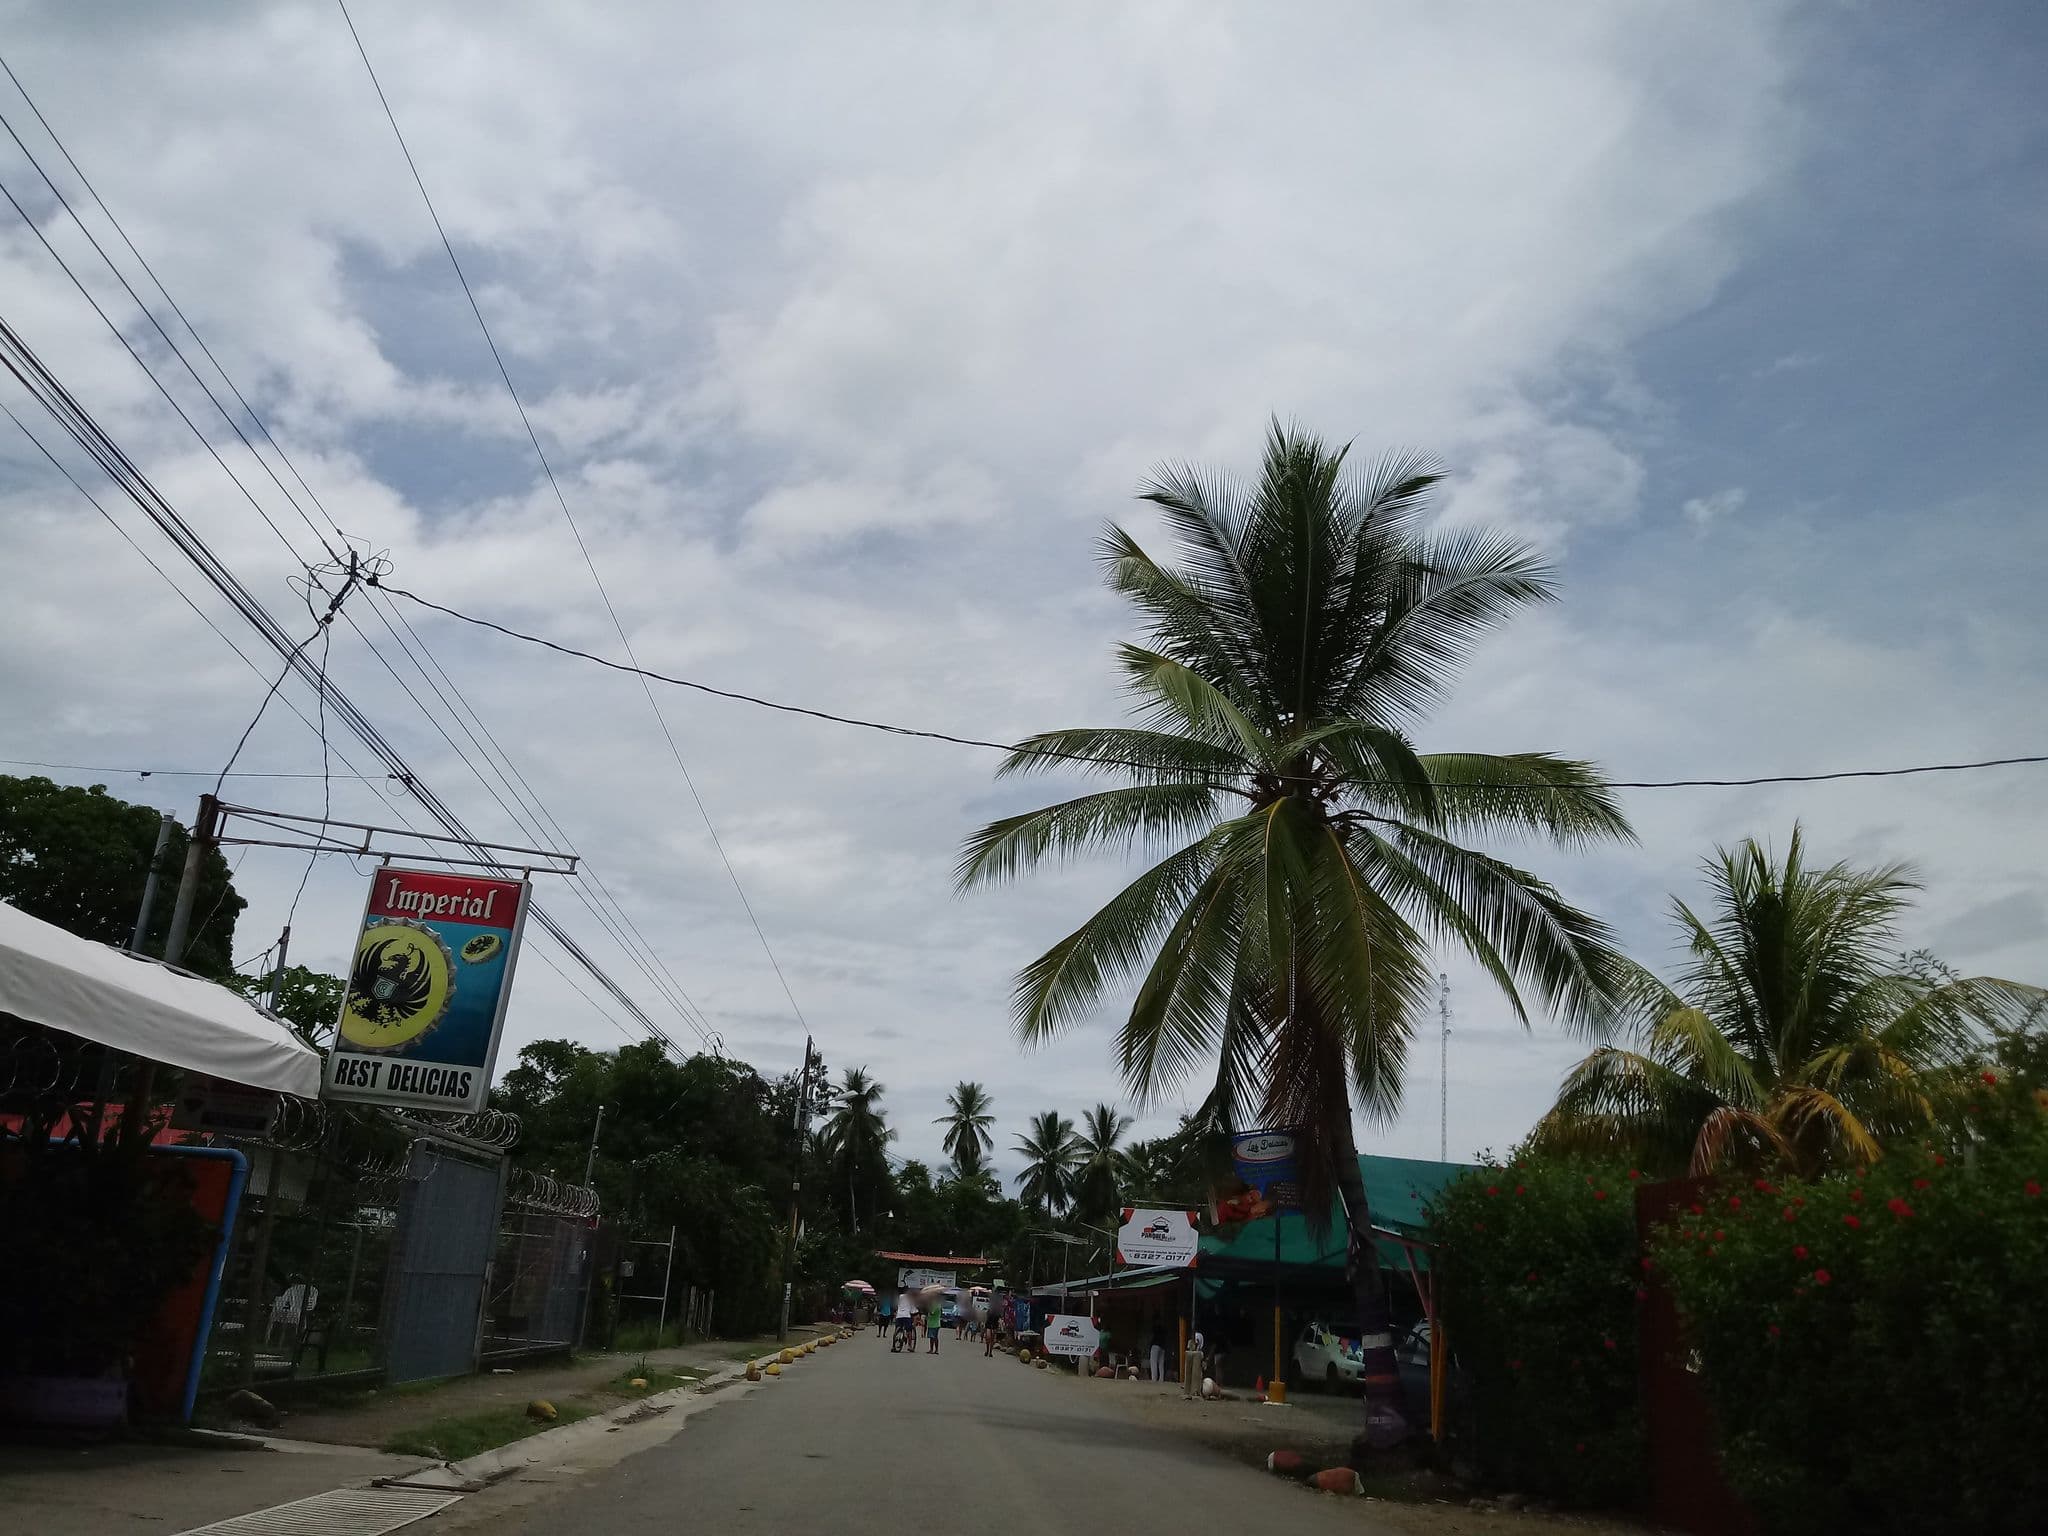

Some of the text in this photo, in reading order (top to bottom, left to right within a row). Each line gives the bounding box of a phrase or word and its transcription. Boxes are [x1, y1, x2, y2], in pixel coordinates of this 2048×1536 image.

[386, 877, 498, 919] Imperial
[334, 1058, 472, 1099] REST DELICIAS
[1133, 1253, 1186, 1261] 8327-0171
